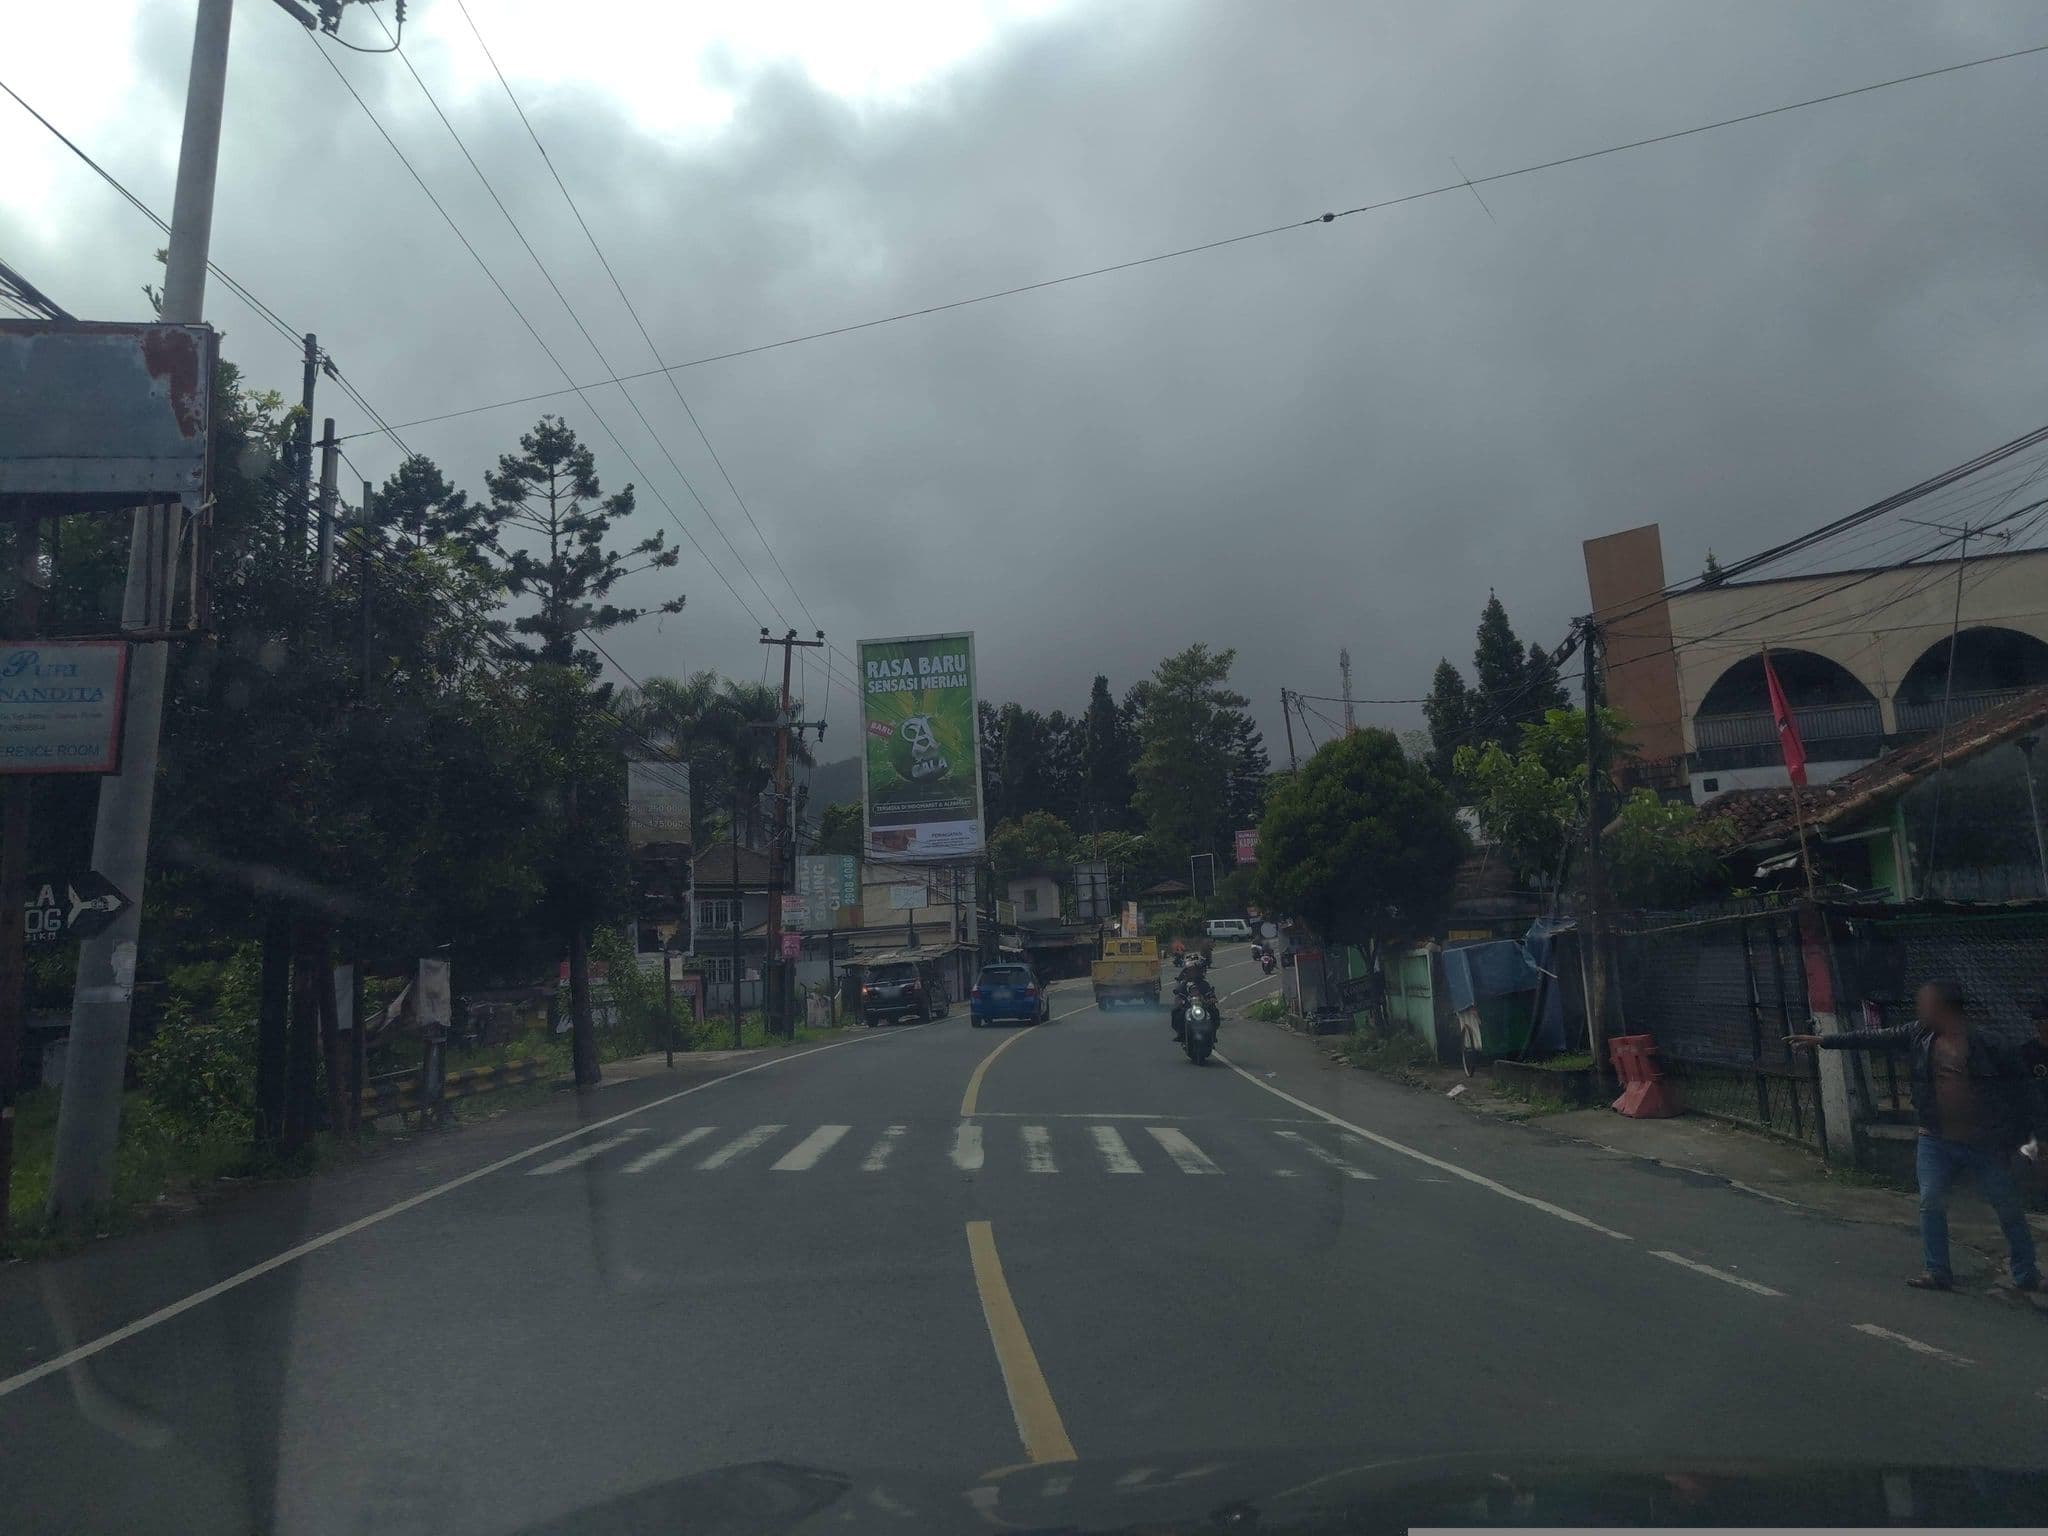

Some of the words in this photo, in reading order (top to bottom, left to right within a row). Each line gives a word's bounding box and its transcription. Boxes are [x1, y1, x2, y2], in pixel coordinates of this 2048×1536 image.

[866, 657, 914, 678] RASA
[918, 653, 966, 674] BARU
[867, 678, 917, 694] SENSASI
[921, 673, 968, 689] MERIAH
[57, 744, 100, 757] ROOM
